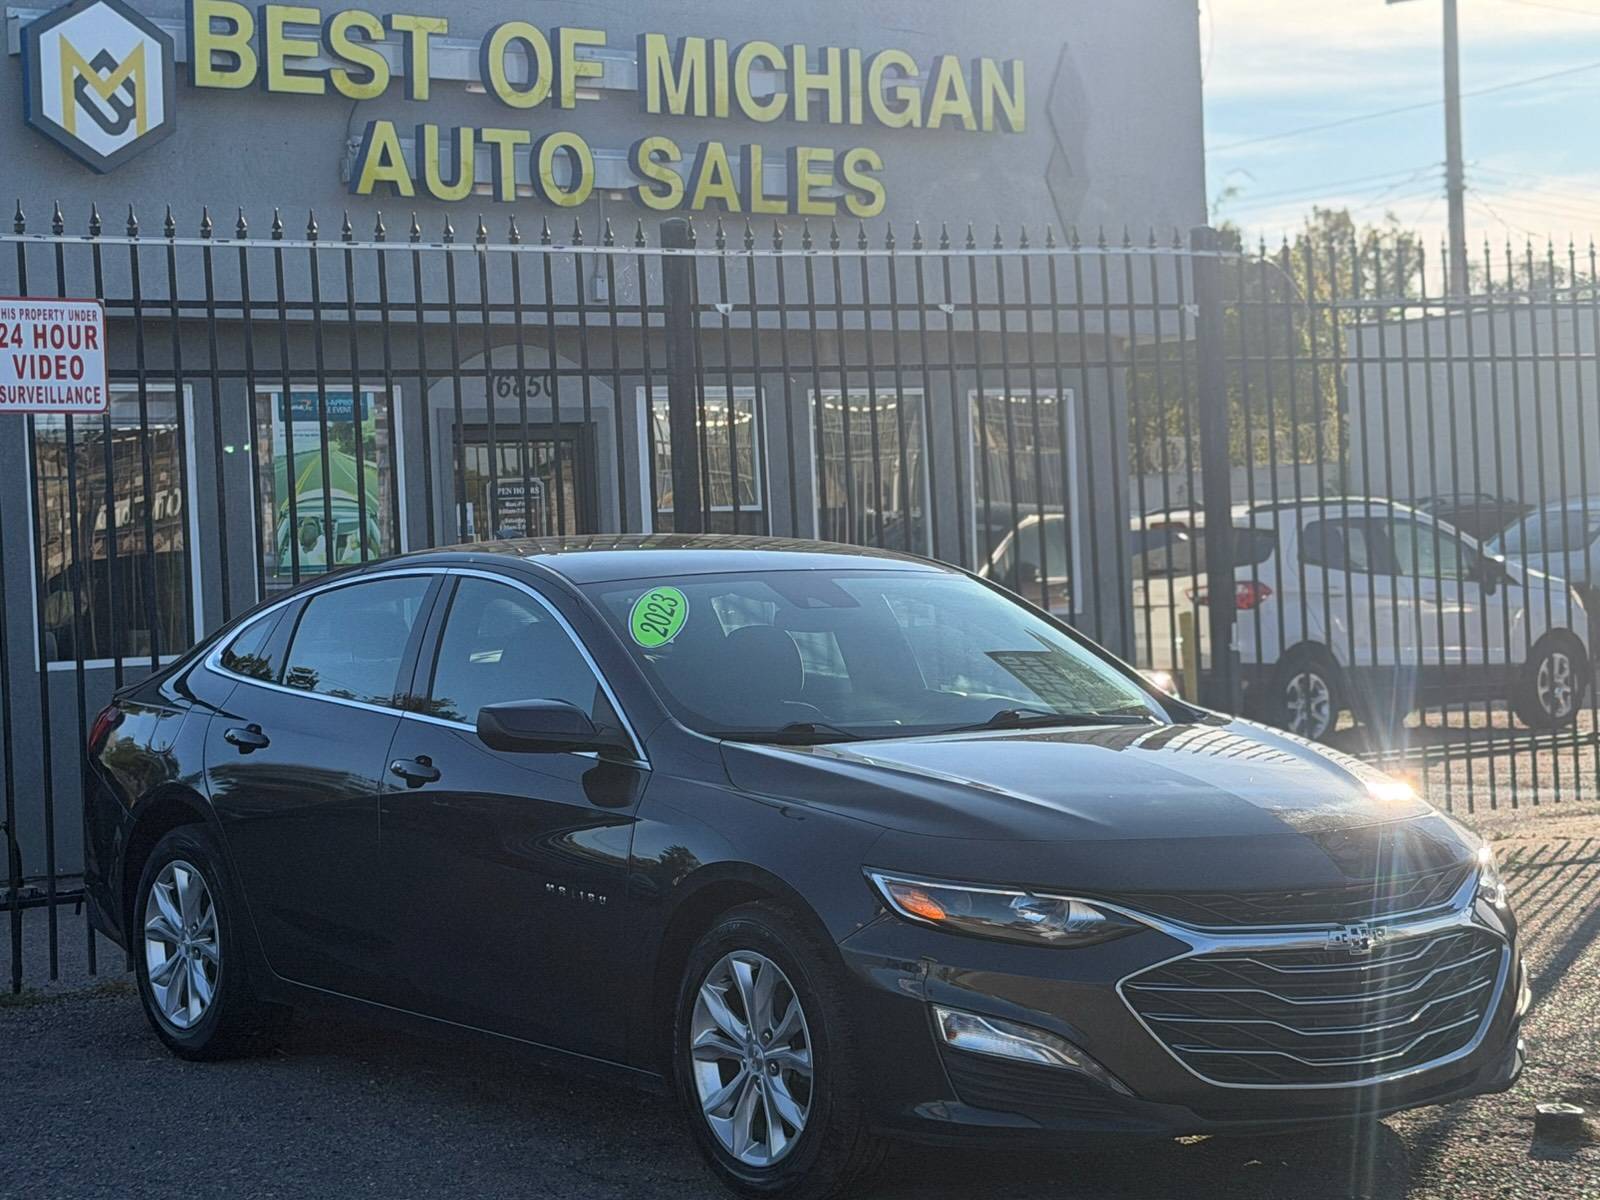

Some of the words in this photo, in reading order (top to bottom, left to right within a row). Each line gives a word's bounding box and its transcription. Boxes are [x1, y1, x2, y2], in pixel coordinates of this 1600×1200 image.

[189, 0, 448, 100] BEST
[482, 21, 607, 109] OF
[641, 33, 1025, 132] MICHIGAN
[354, 120, 595, 207] AUTO
[632, 136, 886, 217] SALES
[0, 308, 16, 320] HIS
[19, 308, 65, 320] PROPERTY
[68, 310, 98, 321] UNDER
[0, 323, 23, 349] 24
[33, 324, 99, 350] HOUR
[12, 354, 84, 380] VIDEO
[0, 385, 101, 404] SURVEILLANCE
[496, 487, 512, 495] PEN
[513, 486, 540, 495] HORS
[640, 593, 678, 638] 2023
